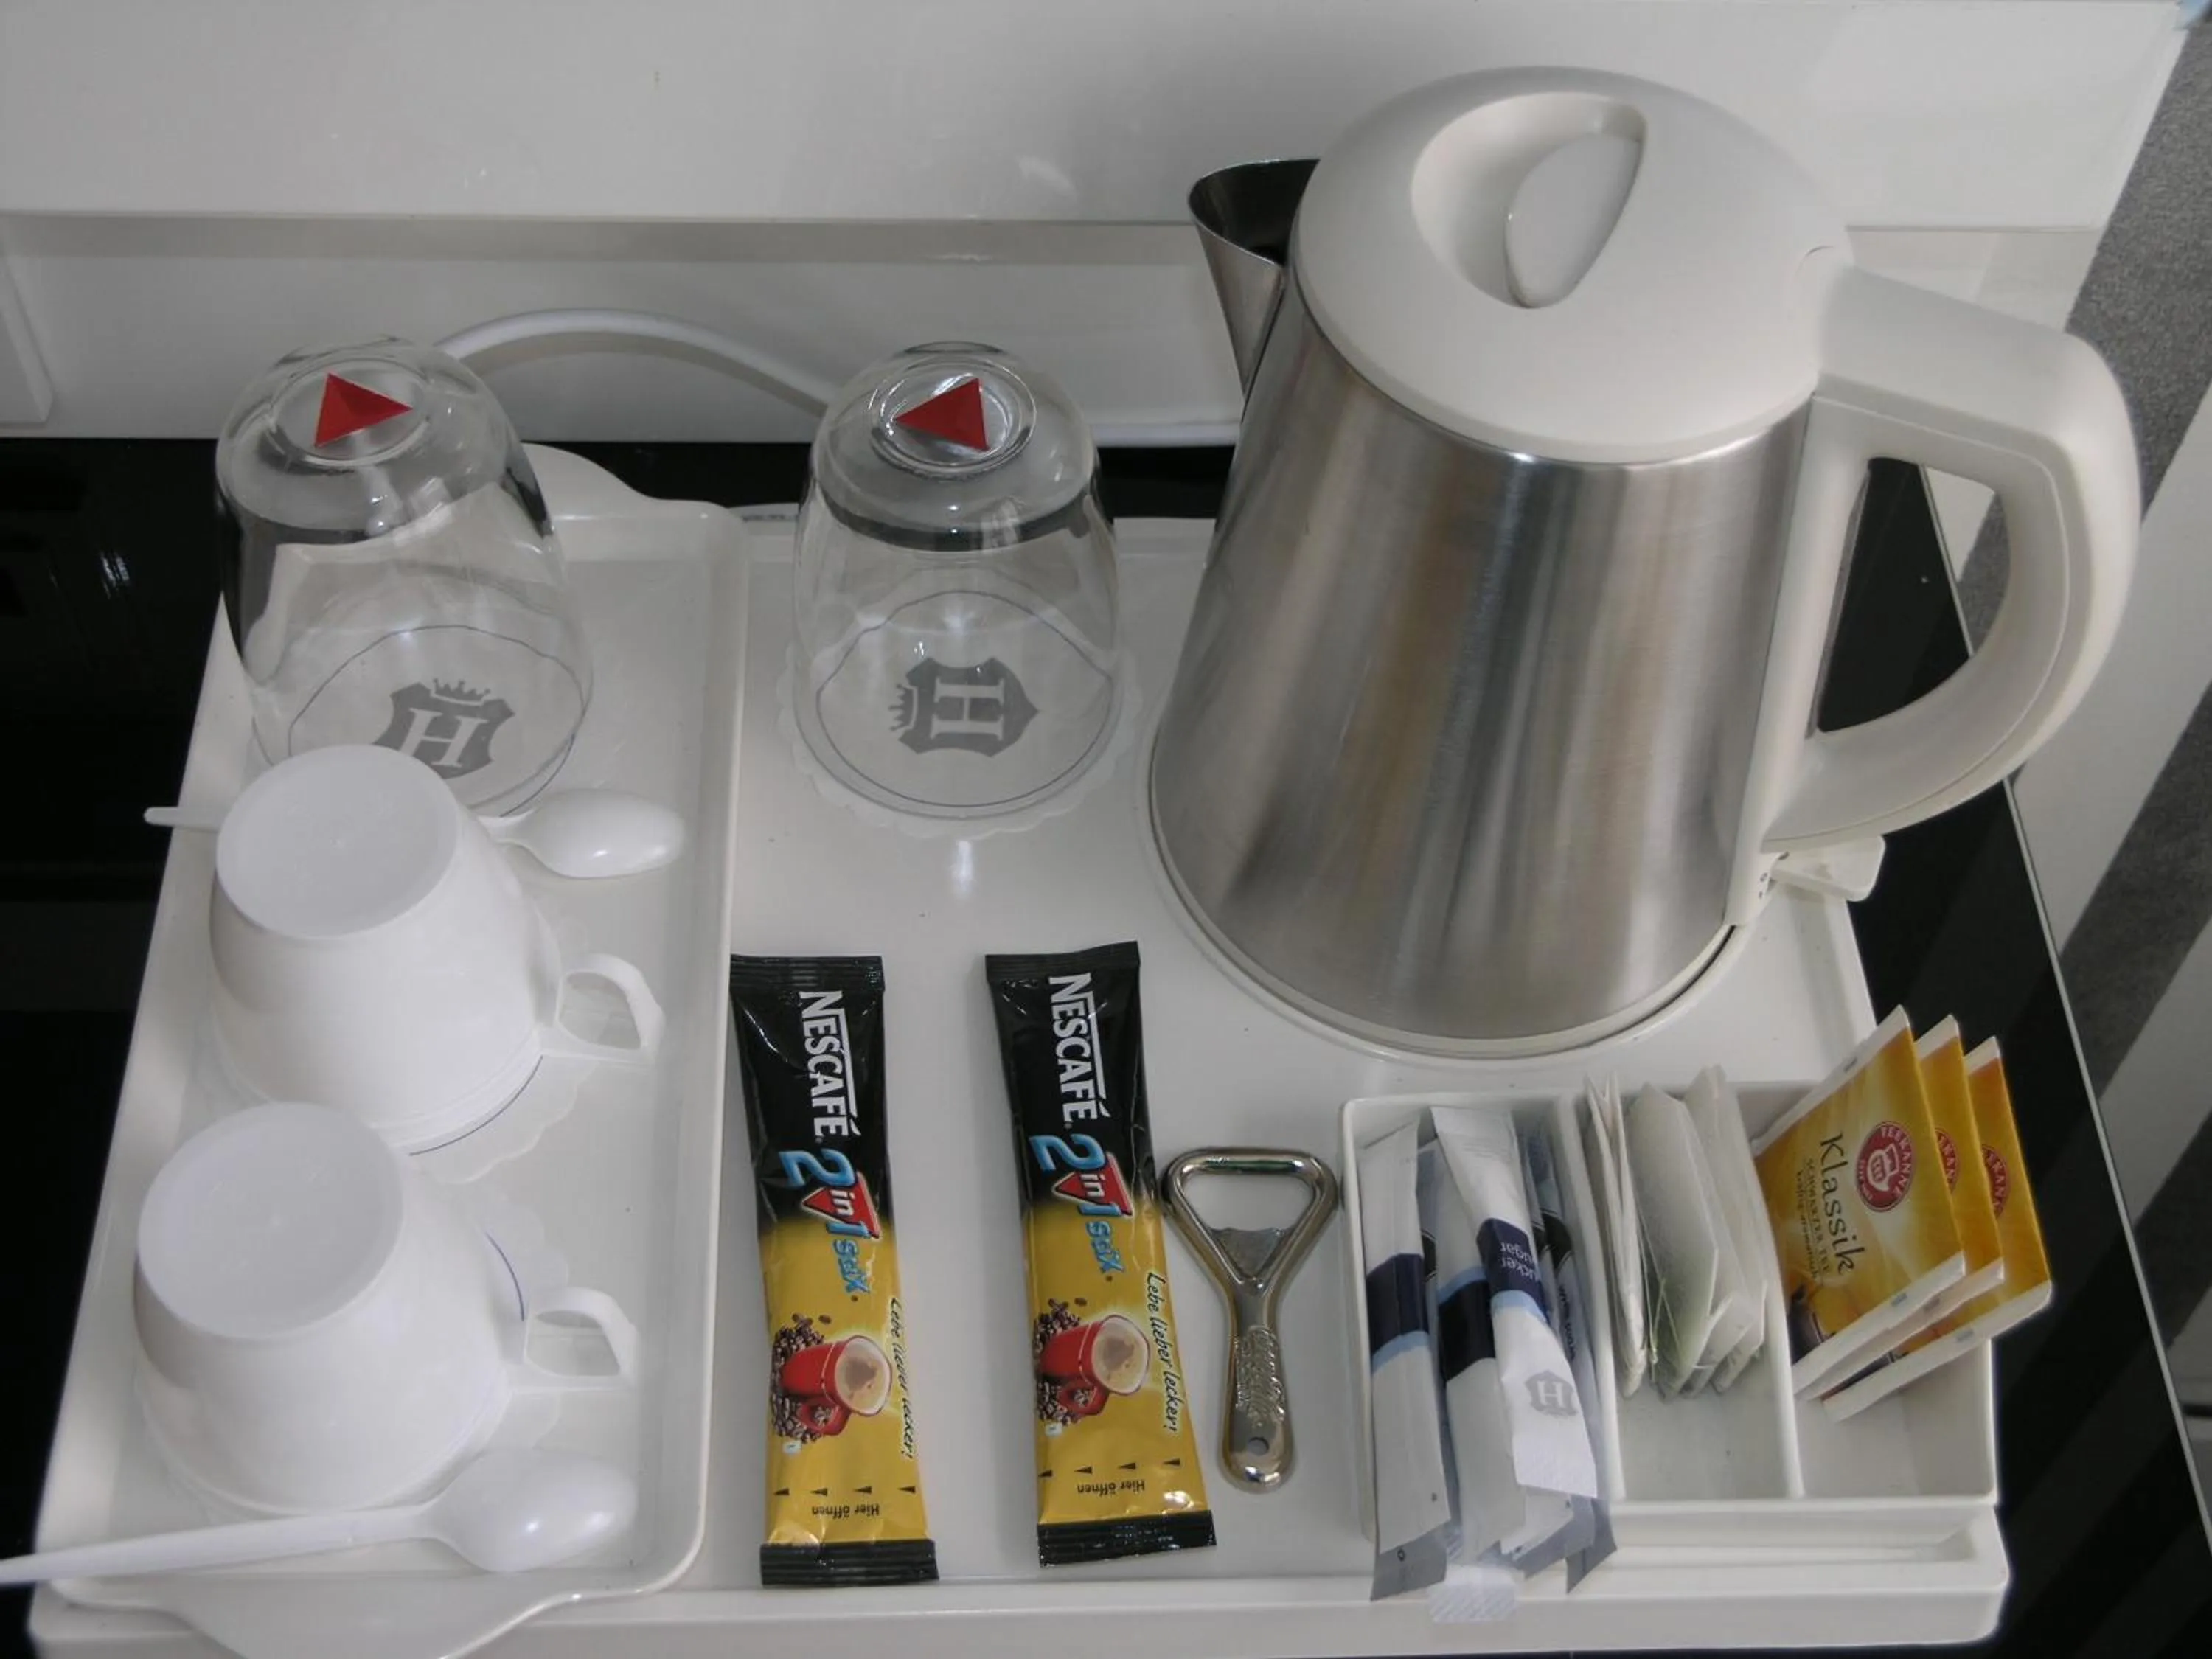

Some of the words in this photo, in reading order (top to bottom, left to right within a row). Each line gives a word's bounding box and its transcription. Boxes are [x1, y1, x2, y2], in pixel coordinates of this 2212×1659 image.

[799, 990, 861, 1136] NESCAFÉ
[1048, 973, 1111, 1122] NESCAFÉ
[1820, 1131, 1865, 1276] Klassik
[1147, 1272, 1166, 1312] Lebe
[1150, 1316, 1172, 1368] lieber
[1163, 1371, 1185, 1432] lecker!
[1077, 1482, 1116, 1497] öffnen
[1120, 1479, 1145, 1493] Hier
[812, 1505, 850, 1520] öffnen
[855, 1503, 880, 1517] Hier
